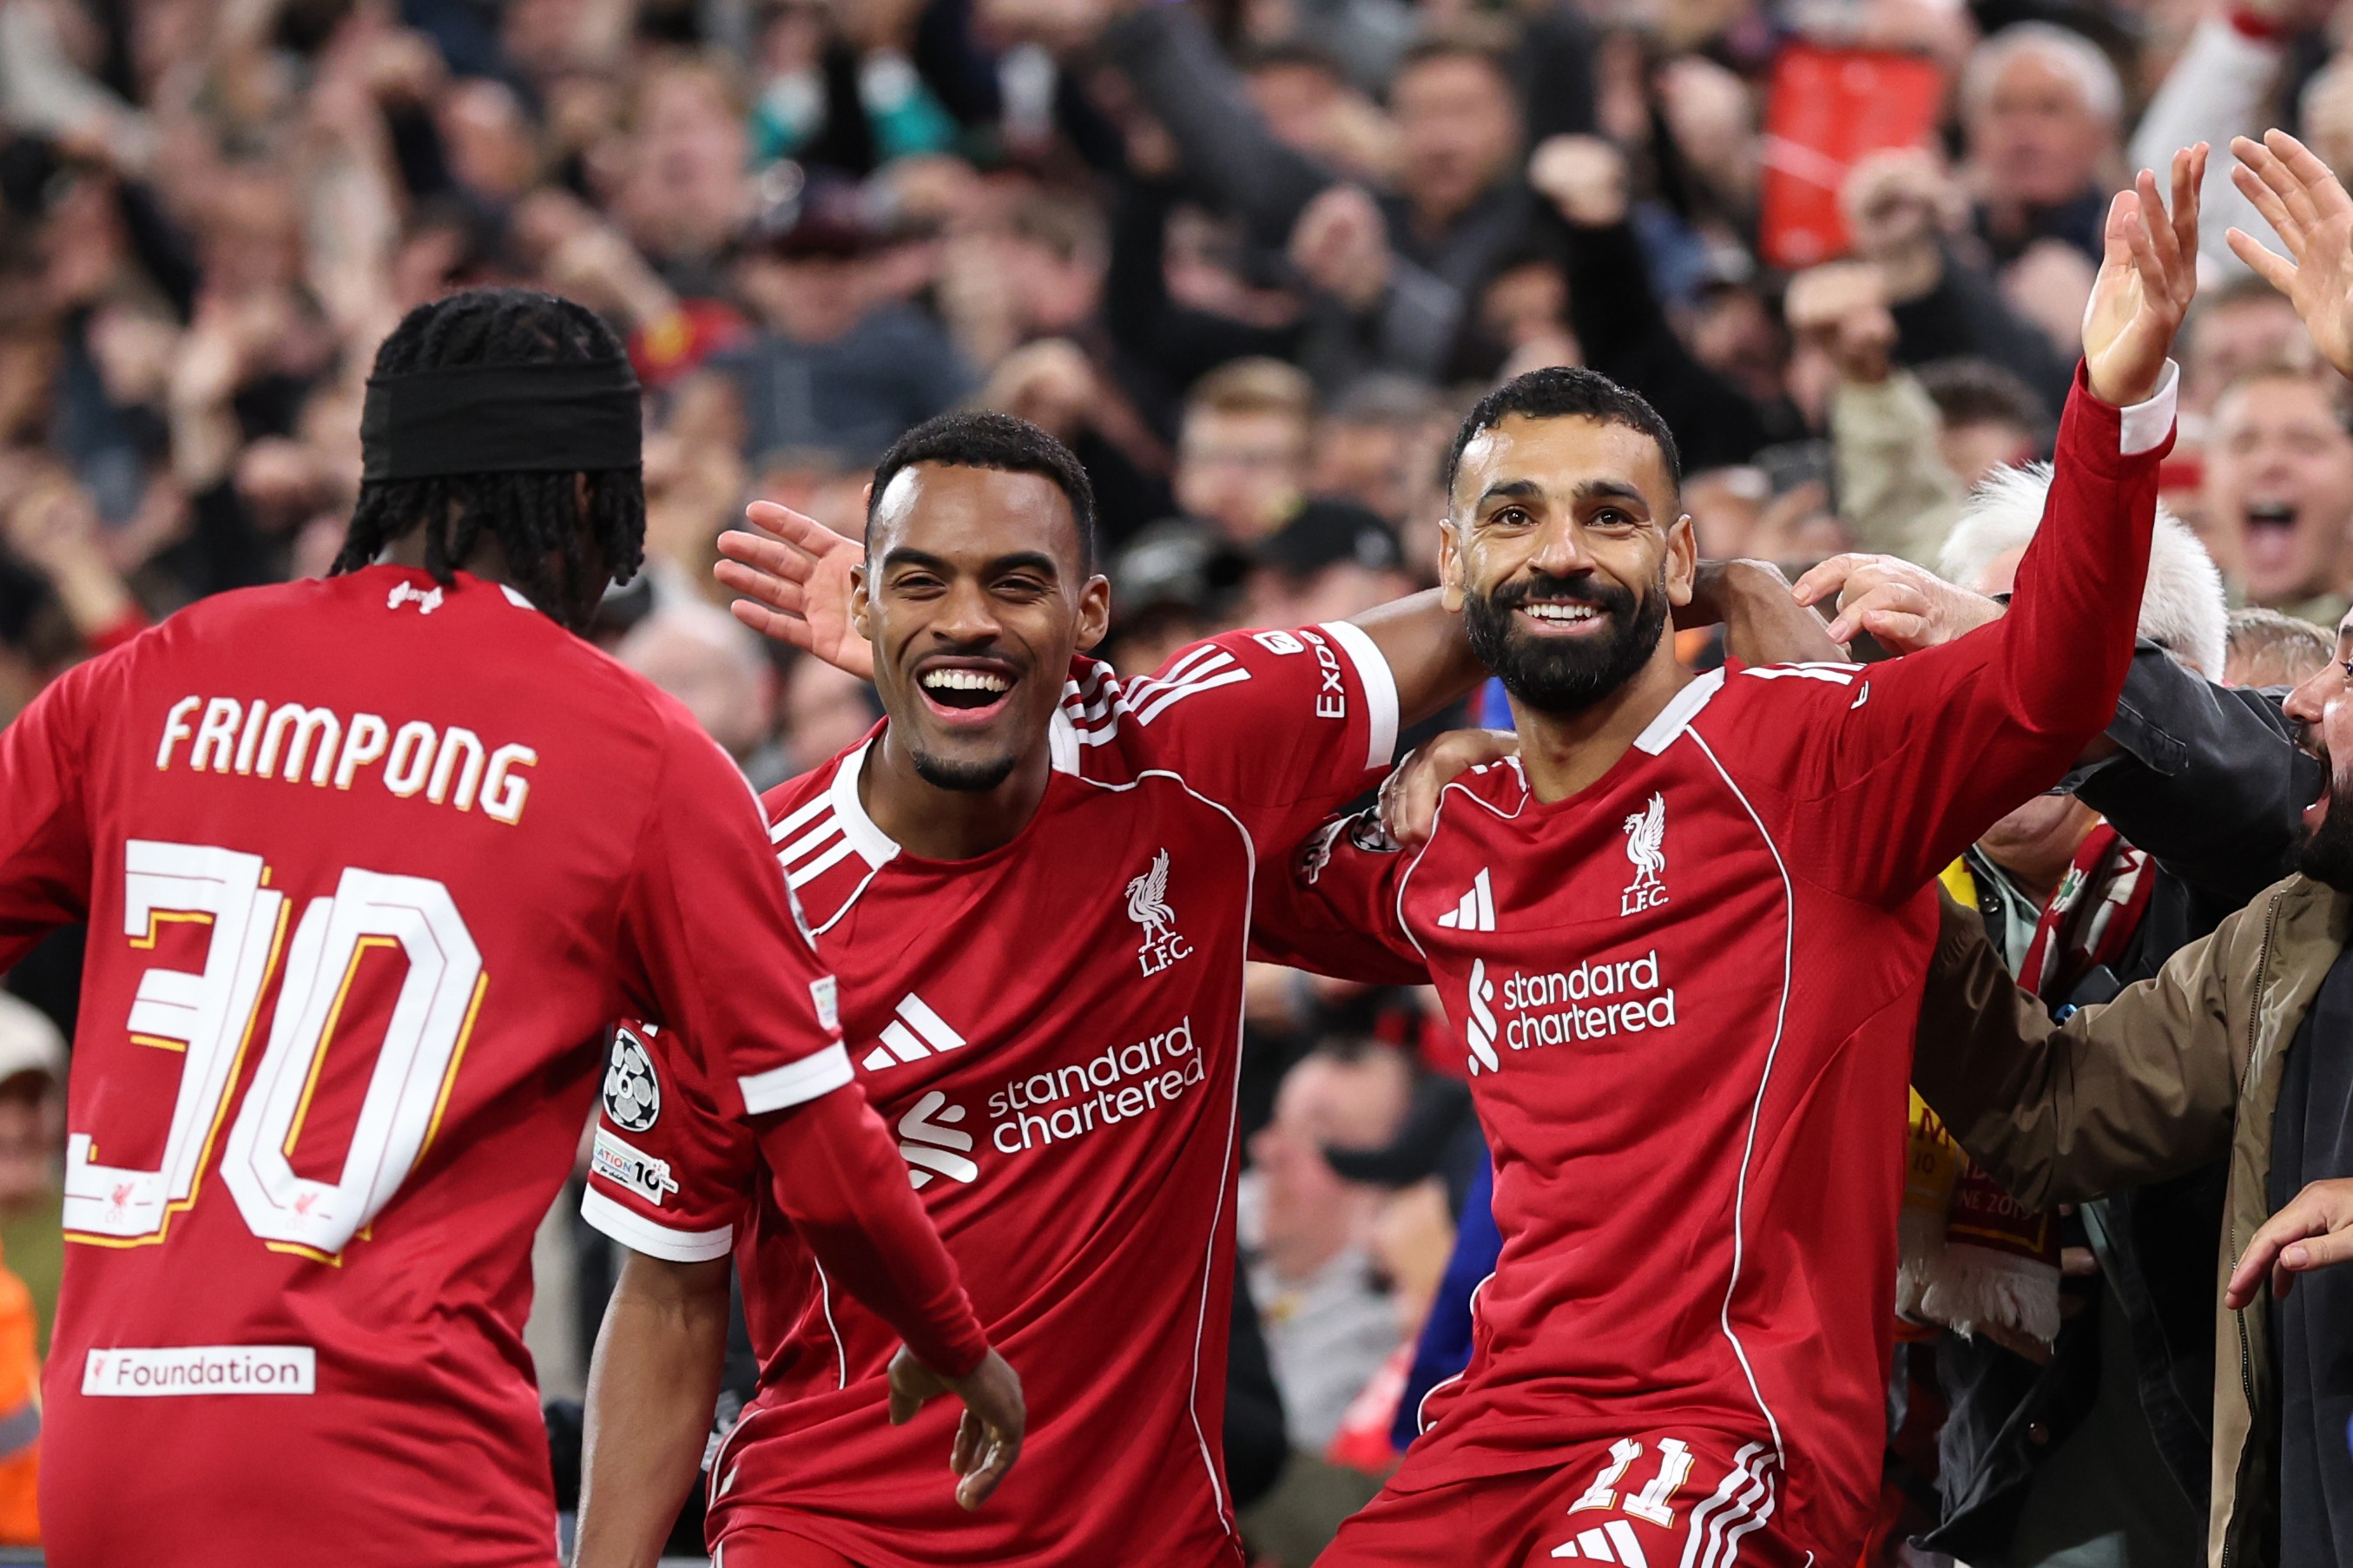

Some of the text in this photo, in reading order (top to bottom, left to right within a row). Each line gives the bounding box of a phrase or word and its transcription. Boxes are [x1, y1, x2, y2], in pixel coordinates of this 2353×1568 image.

[1300, 630, 1345, 718] Expe
[156, 695, 537, 826] FRIMPONG
[1620, 885, 1670, 917] L.F.C.
[1137, 937, 1194, 978] L.F.C.
[1504, 950, 1658, 1011] standard
[1506, 989, 1676, 1051] chartered
[63, 839, 489, 1268] 30
[616, 1063, 634, 1100] 6
[989, 1016, 1194, 1118] standard
[992, 1047, 1205, 1154] chartered
[635, 1161, 660, 1190] 10
[117, 1355, 299, 1387] Foundation
[1567, 1438, 1696, 1529] 11
